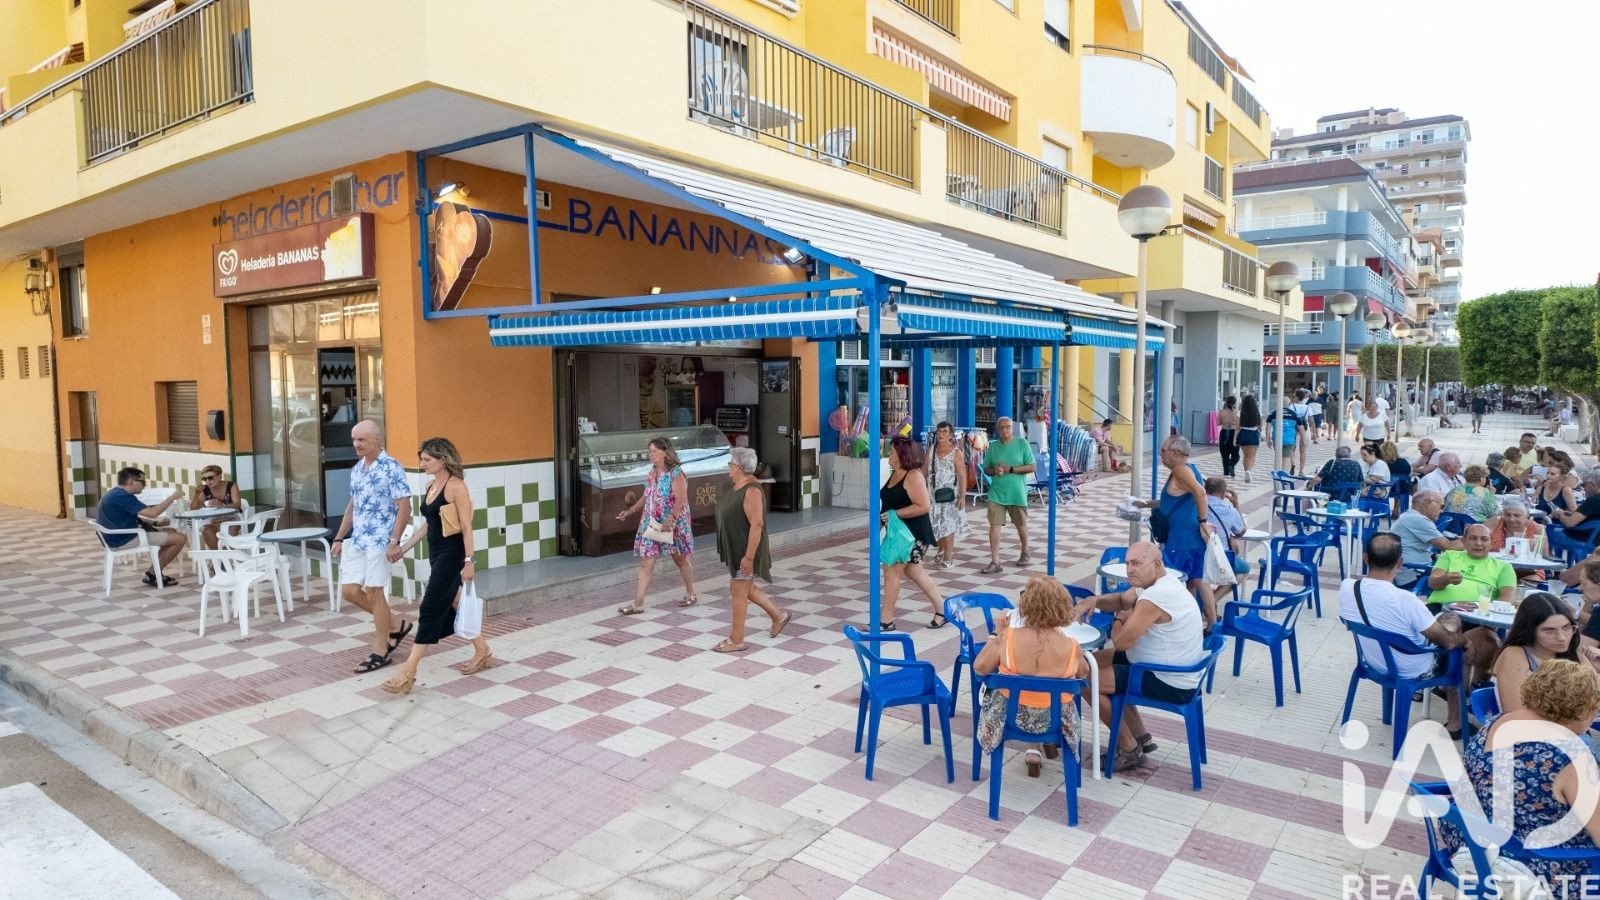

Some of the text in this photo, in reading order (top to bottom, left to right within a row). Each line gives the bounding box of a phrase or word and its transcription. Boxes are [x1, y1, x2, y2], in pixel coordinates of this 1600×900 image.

[241, 246, 320, 272] Heladería BANANAS
[219, 276, 238, 288] FRIGO
